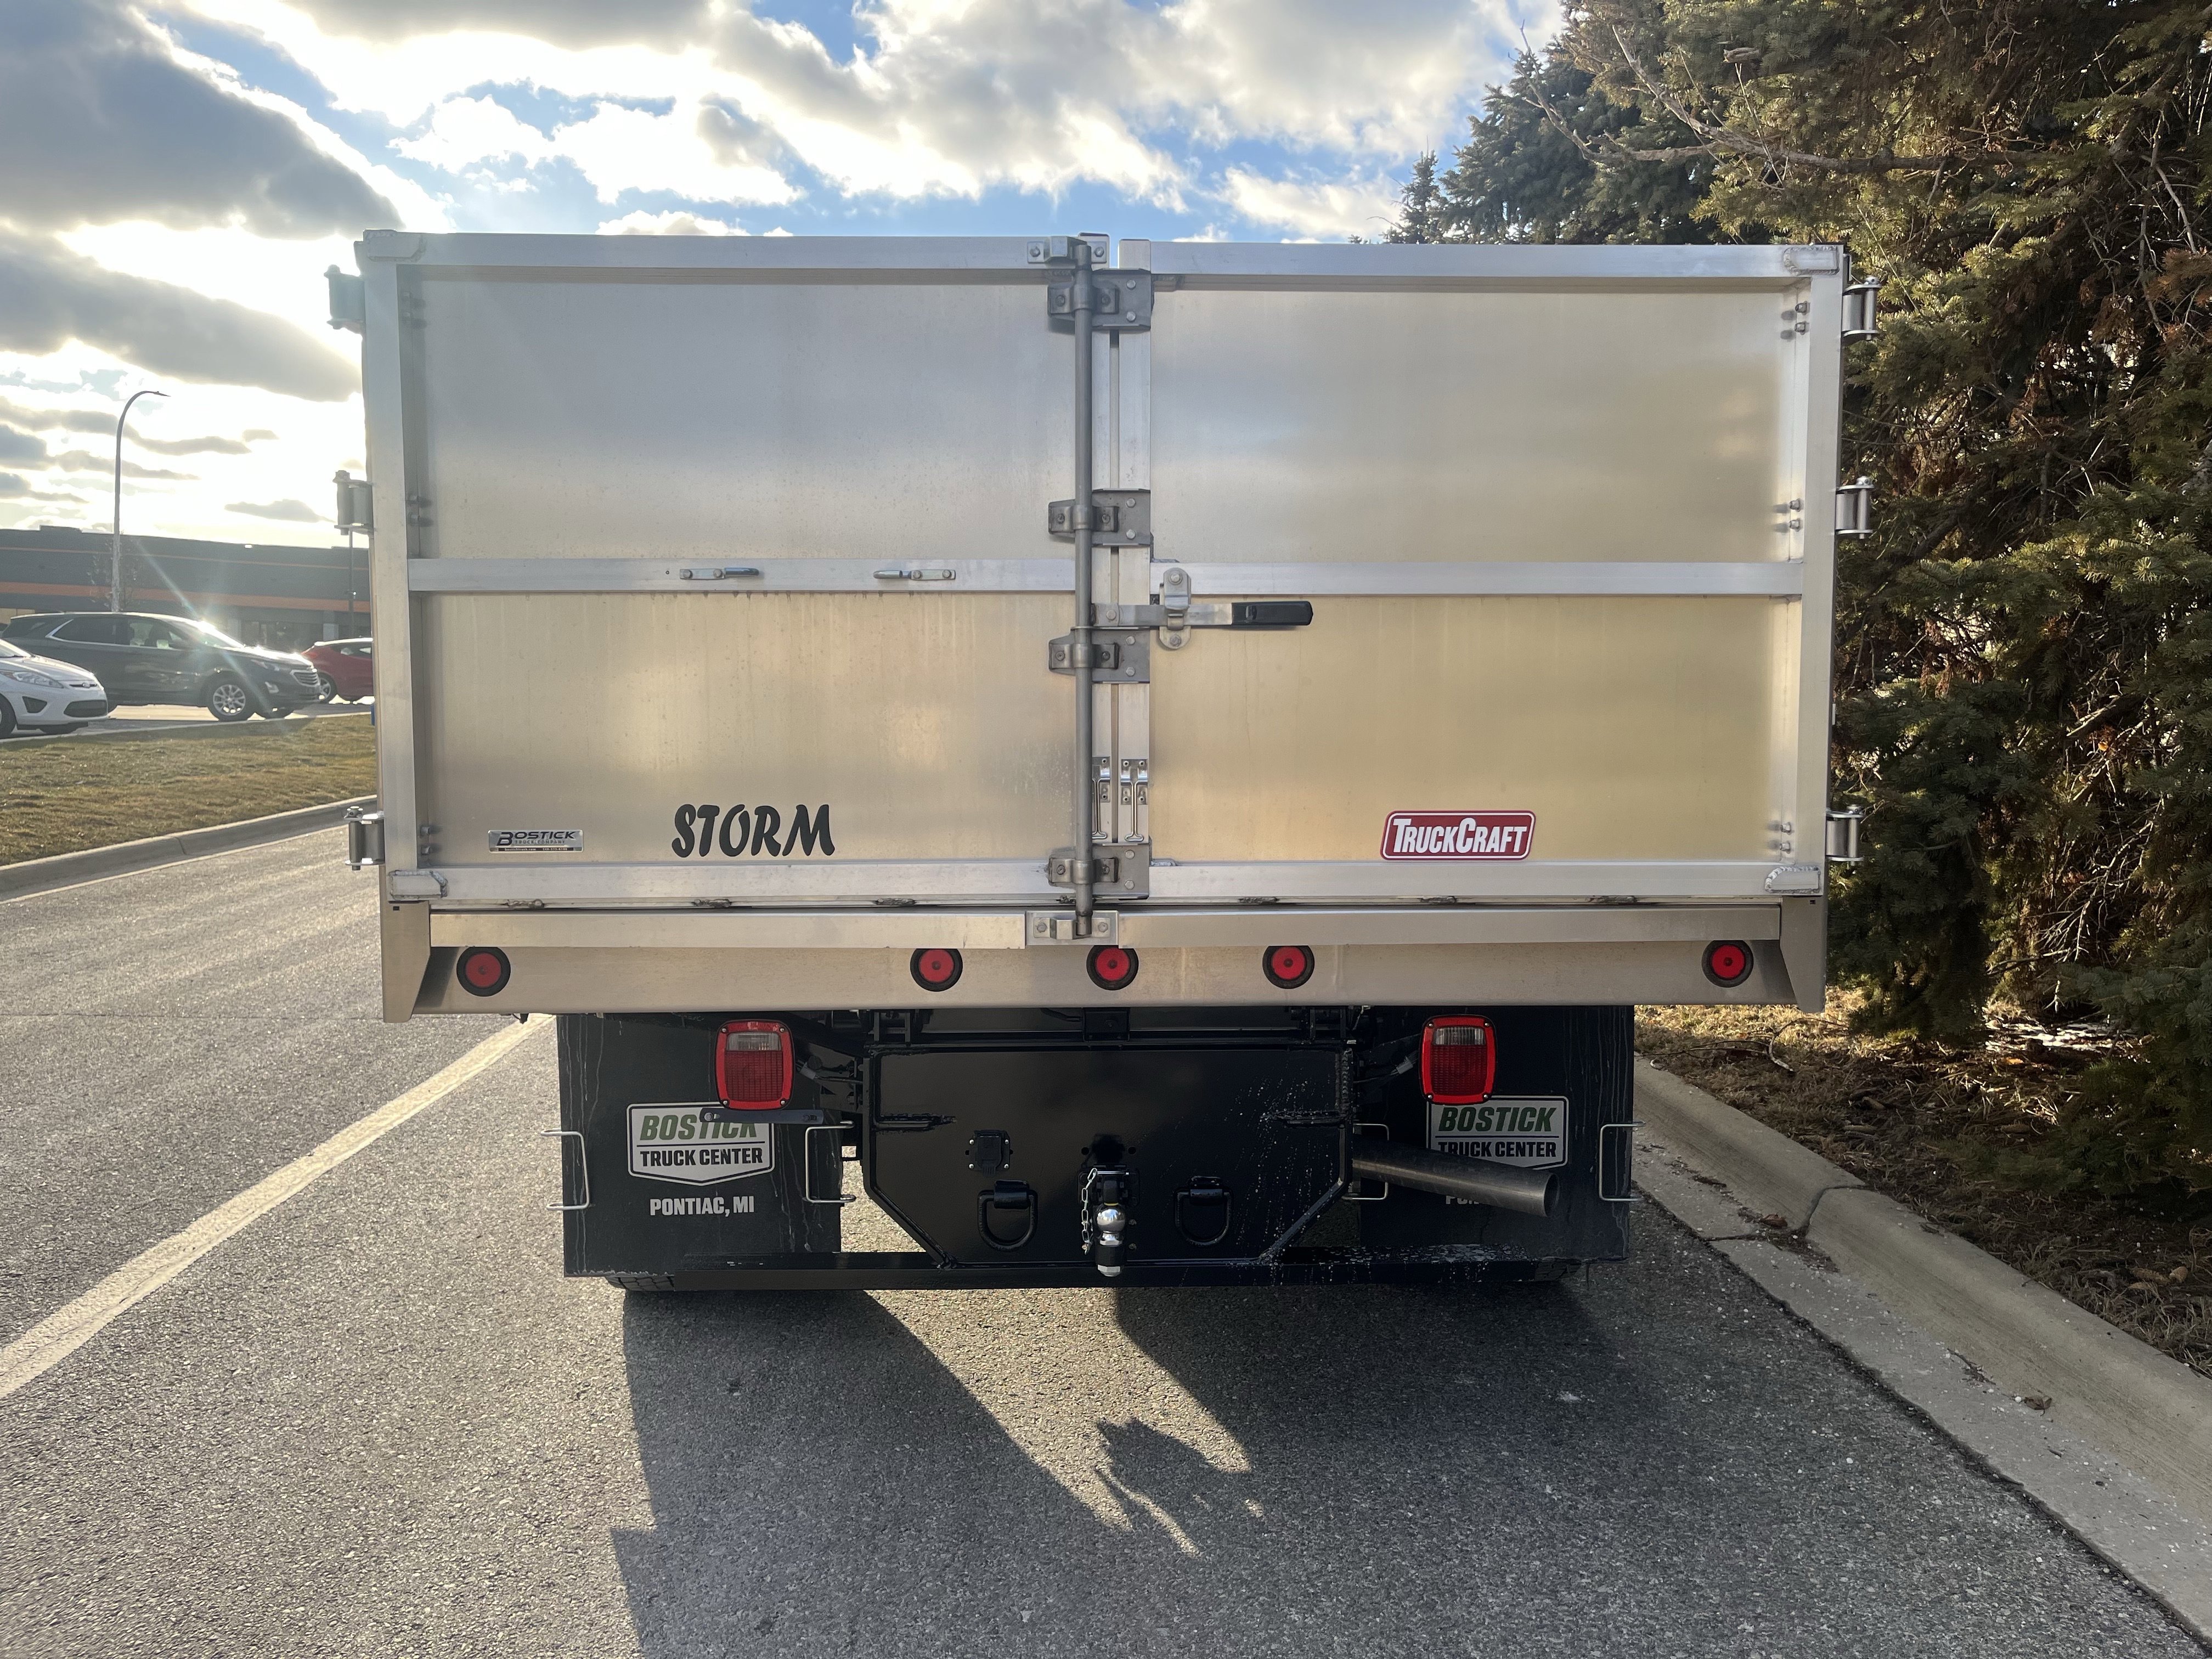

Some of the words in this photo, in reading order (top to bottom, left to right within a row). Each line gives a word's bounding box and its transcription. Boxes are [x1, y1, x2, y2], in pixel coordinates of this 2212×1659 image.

[496, 831, 576, 846] BOSTICK
[672, 804, 835, 857] STORM
[1438, 1107, 1557, 1132] BOSTICK
[640, 1149, 696, 1167] TRUCK
[699, 1147, 763, 1165] CENTER
[1438, 1141, 1492, 1158] TRUCK
[1495, 1141, 1557, 1158] CENTER
[650, 1197, 730, 1217] PONTIAC,
[732, 1195, 755, 1213] MI
